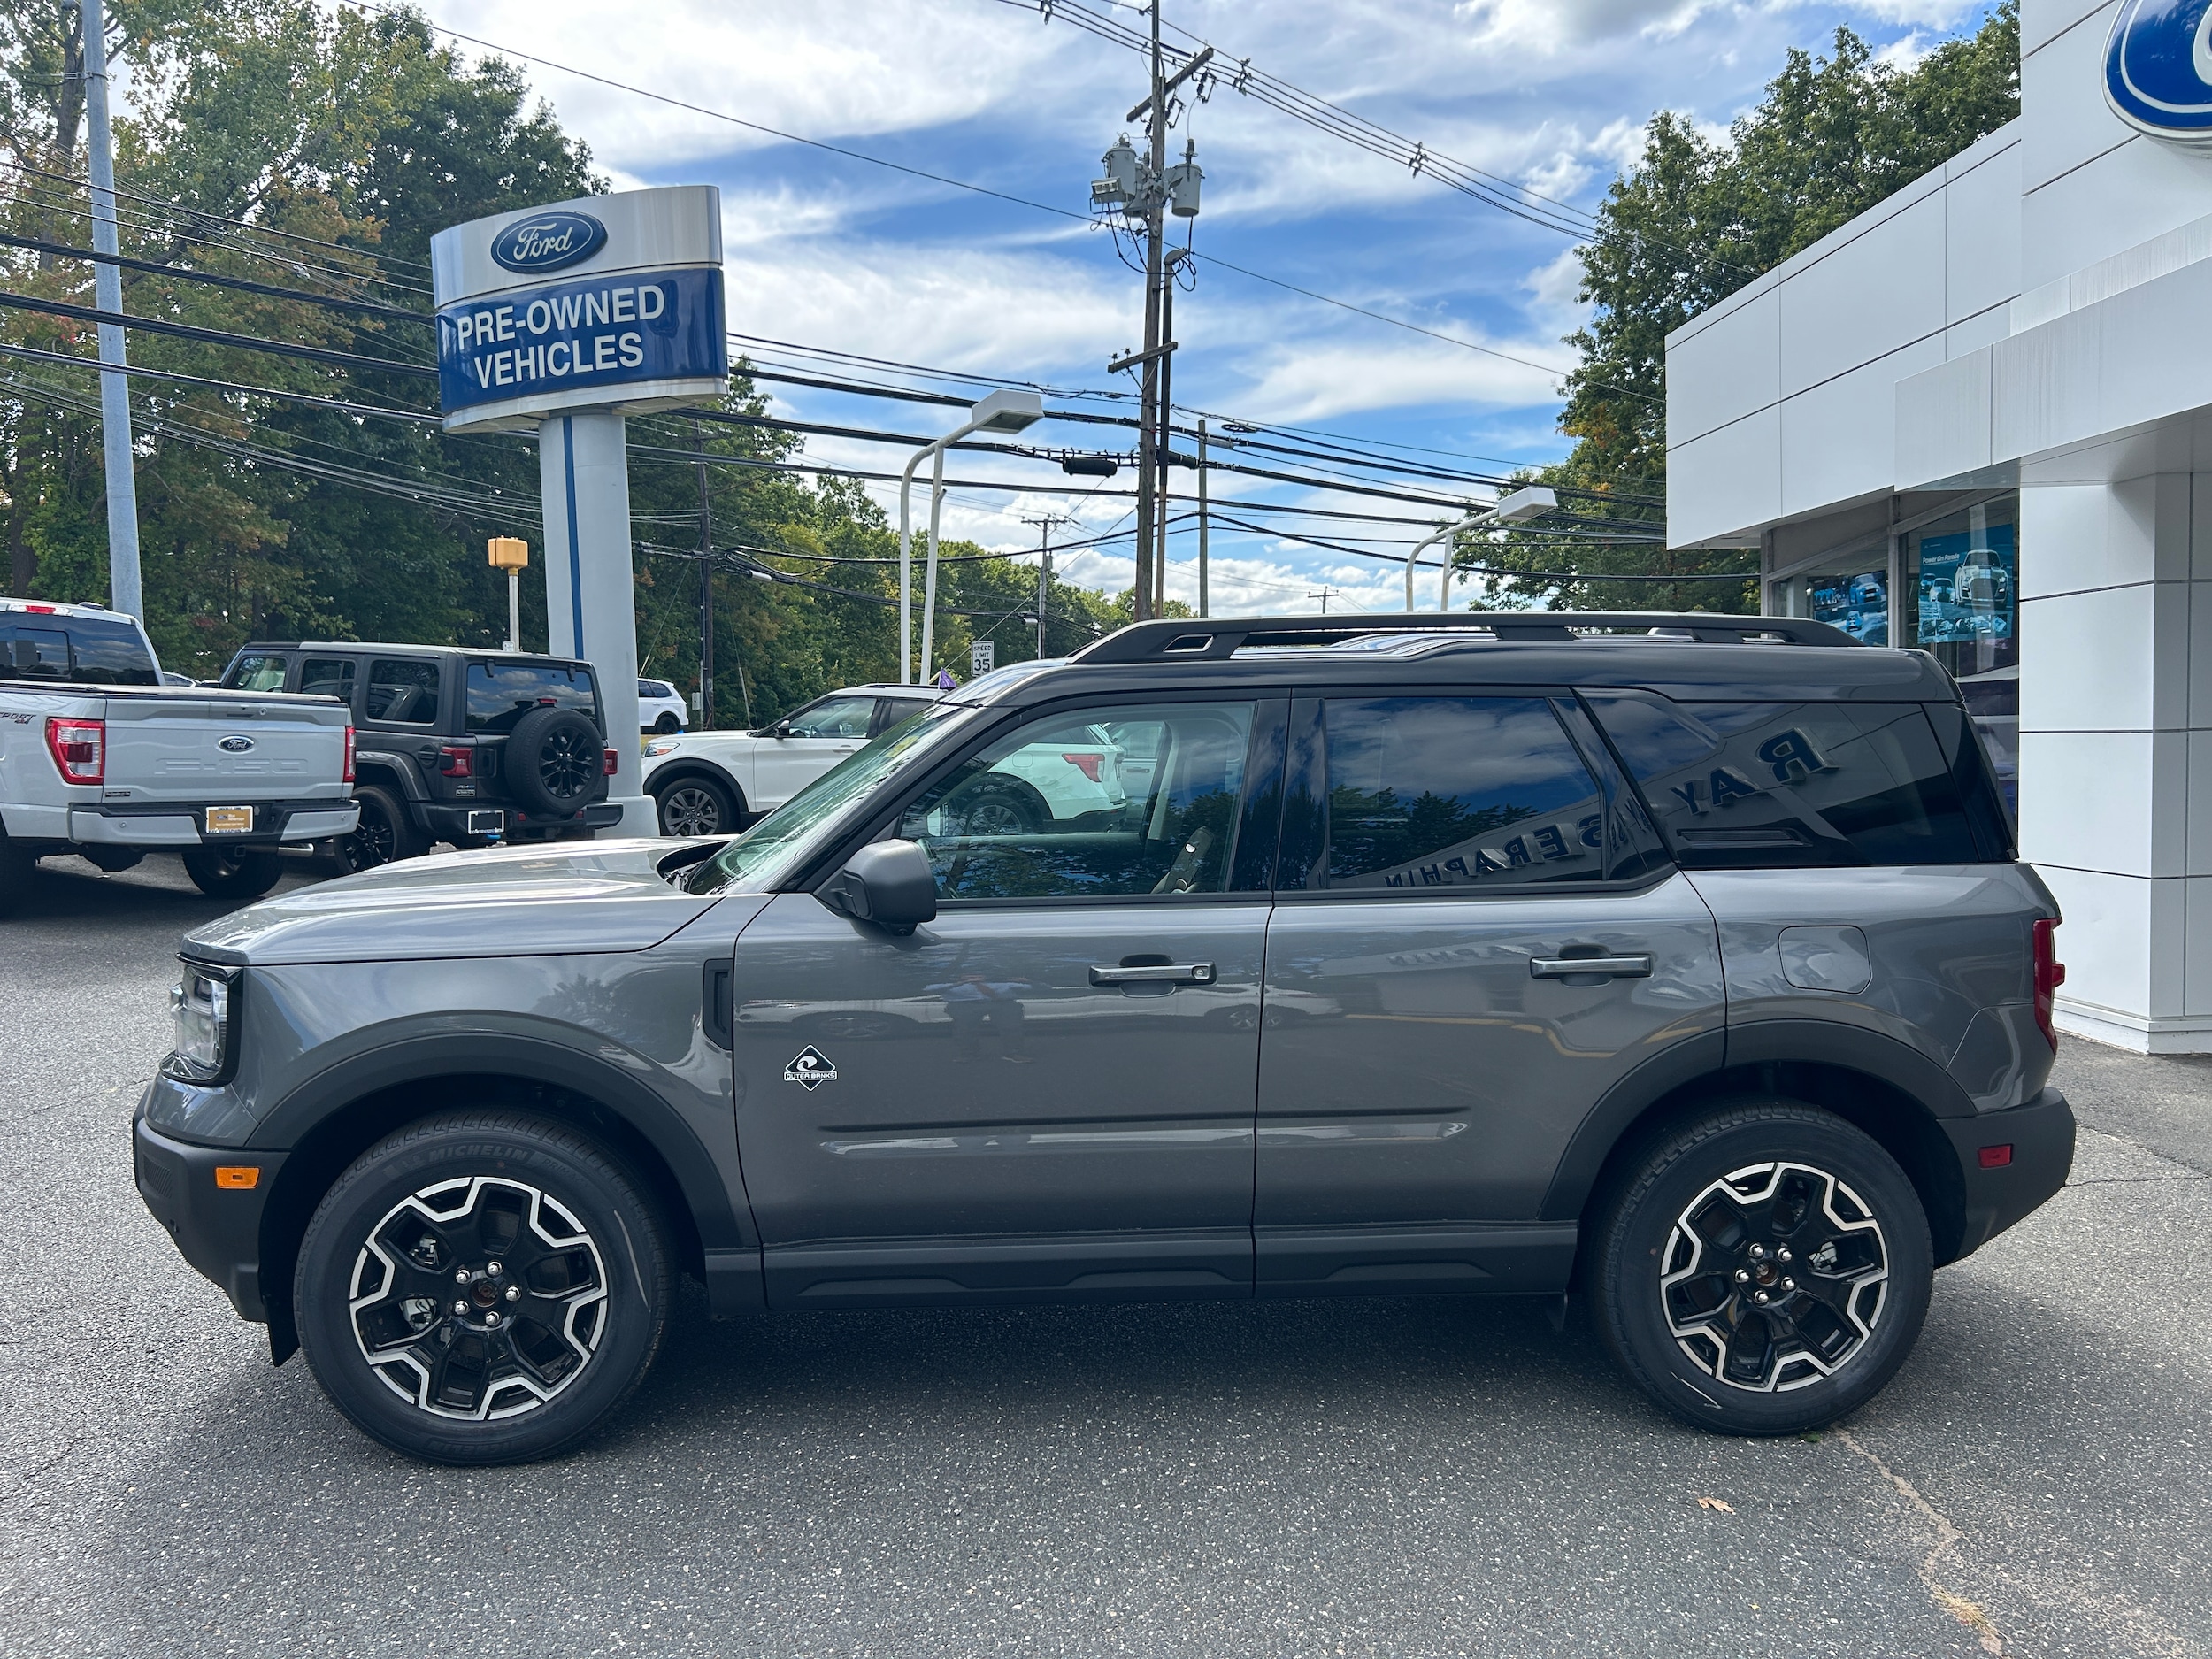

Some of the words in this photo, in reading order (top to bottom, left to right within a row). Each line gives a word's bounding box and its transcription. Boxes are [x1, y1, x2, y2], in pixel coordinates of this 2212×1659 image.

[513, 222, 573, 261] Ford
[457, 285, 665, 349] PRE-OWNED
[474, 332, 644, 388] VEHICLES
[974, 658, 990, 672] 35
[227, 739, 248, 749] Ford
[429, 1145, 528, 1163] MICHELIN
